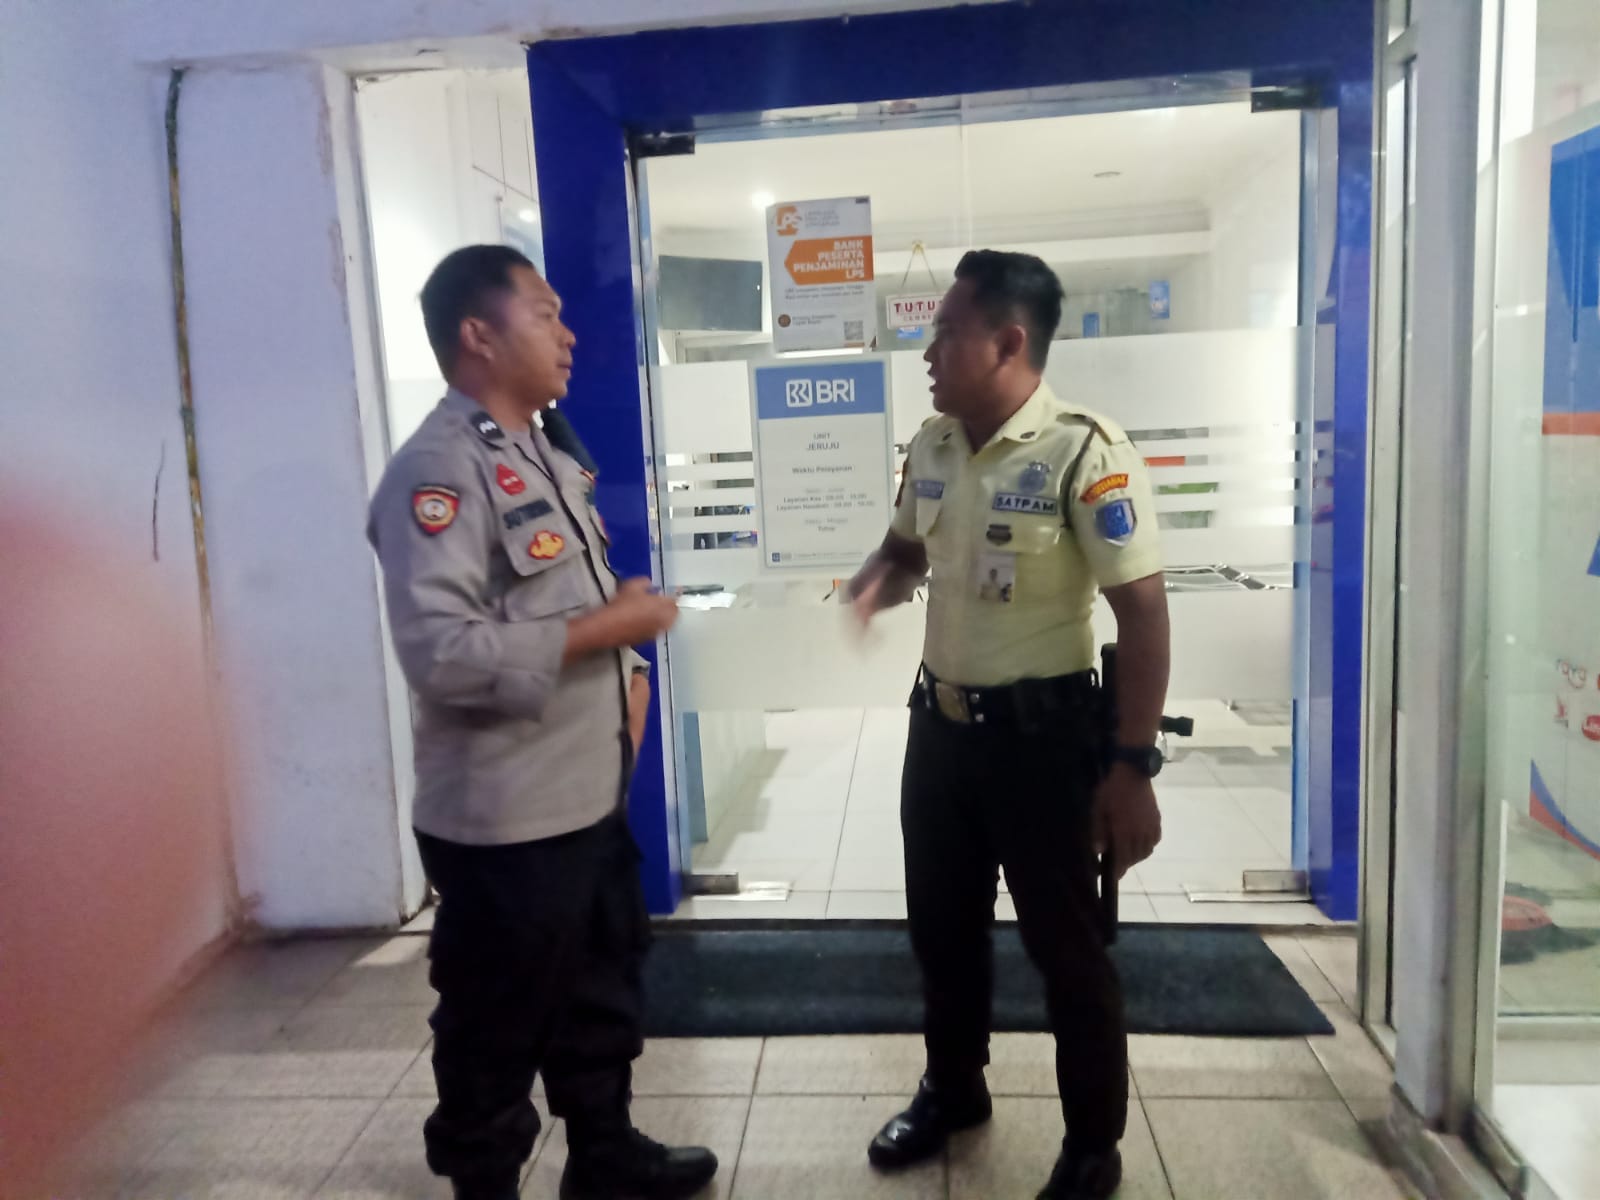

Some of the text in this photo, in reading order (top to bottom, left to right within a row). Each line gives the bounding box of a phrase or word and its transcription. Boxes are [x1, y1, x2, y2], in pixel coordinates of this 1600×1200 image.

[834, 240, 864, 250] BANK
[818, 249, 864, 261] PESERTA
[793, 260, 864, 272] PENJAMINAN
[846, 270, 865, 279] LPS
[893, 300, 942, 313] TUTU
[816, 378, 855, 404] BRI
[806, 441, 840, 451] JERUJU
[996, 496, 1055, 512] SATPAM
